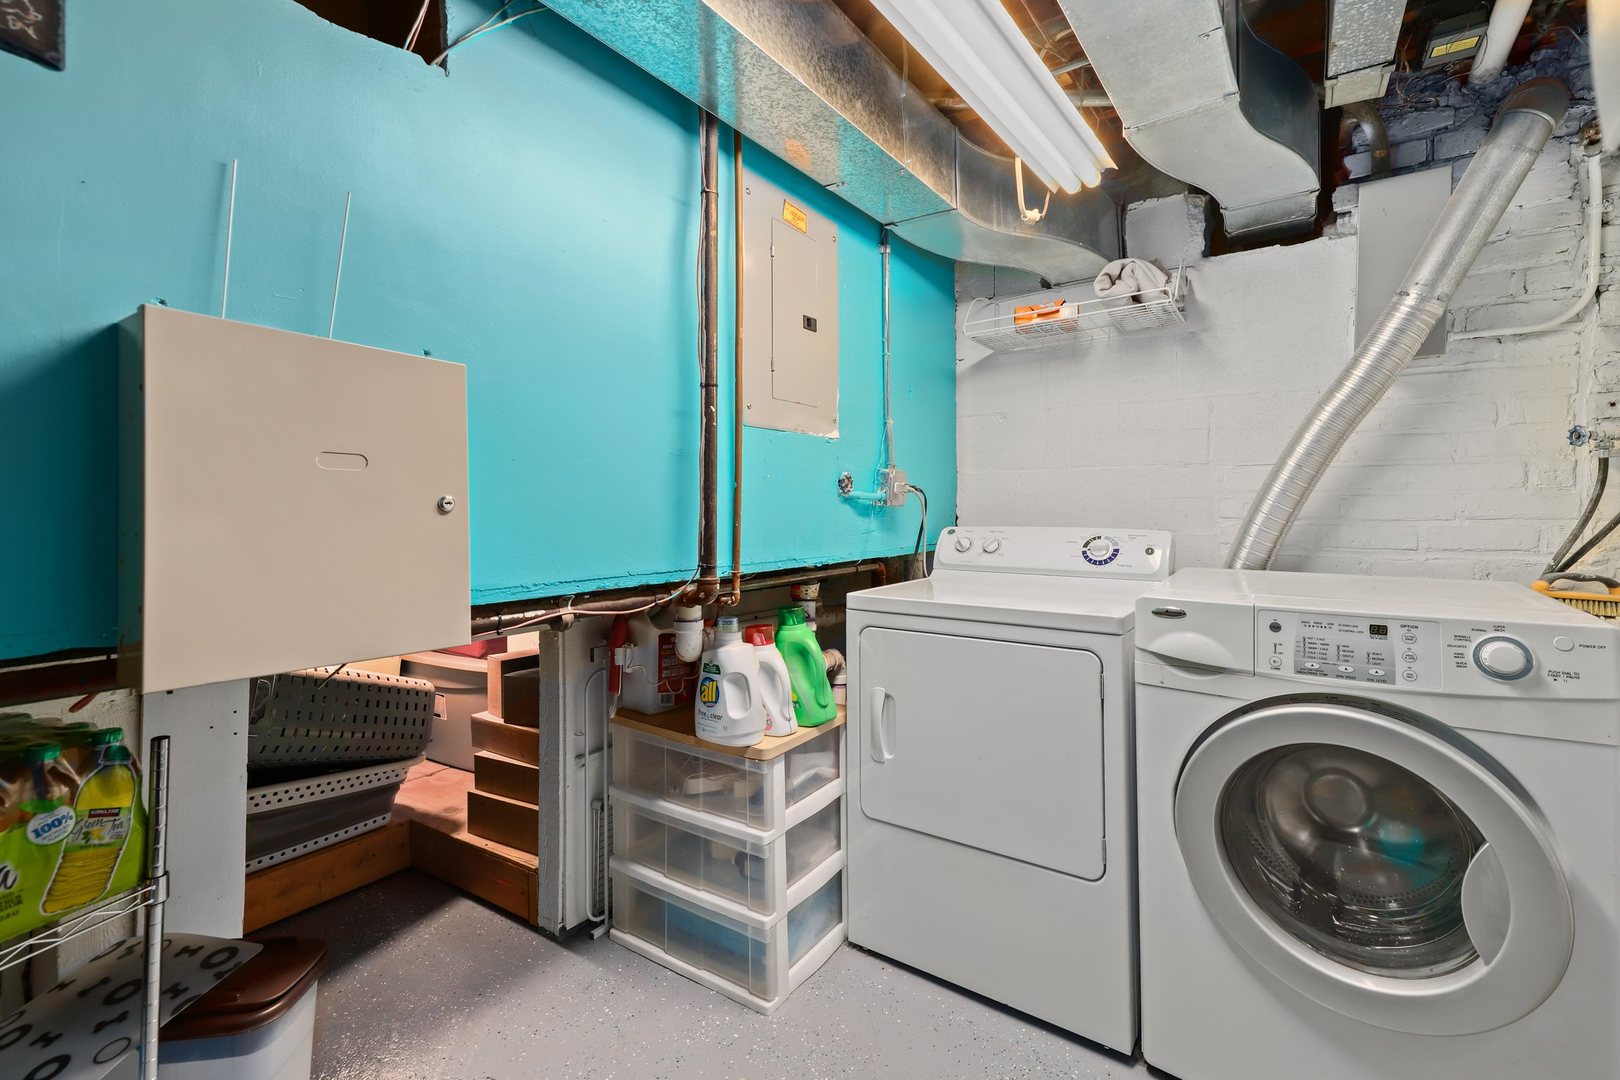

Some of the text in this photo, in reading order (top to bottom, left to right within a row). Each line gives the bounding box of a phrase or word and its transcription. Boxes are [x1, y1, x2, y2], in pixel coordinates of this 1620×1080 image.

[701, 680, 717, 702] all
[32, 812, 73, 839] 100%
[73, 818, 105, 840] Green
[104, 817, 125, 834] Tea
